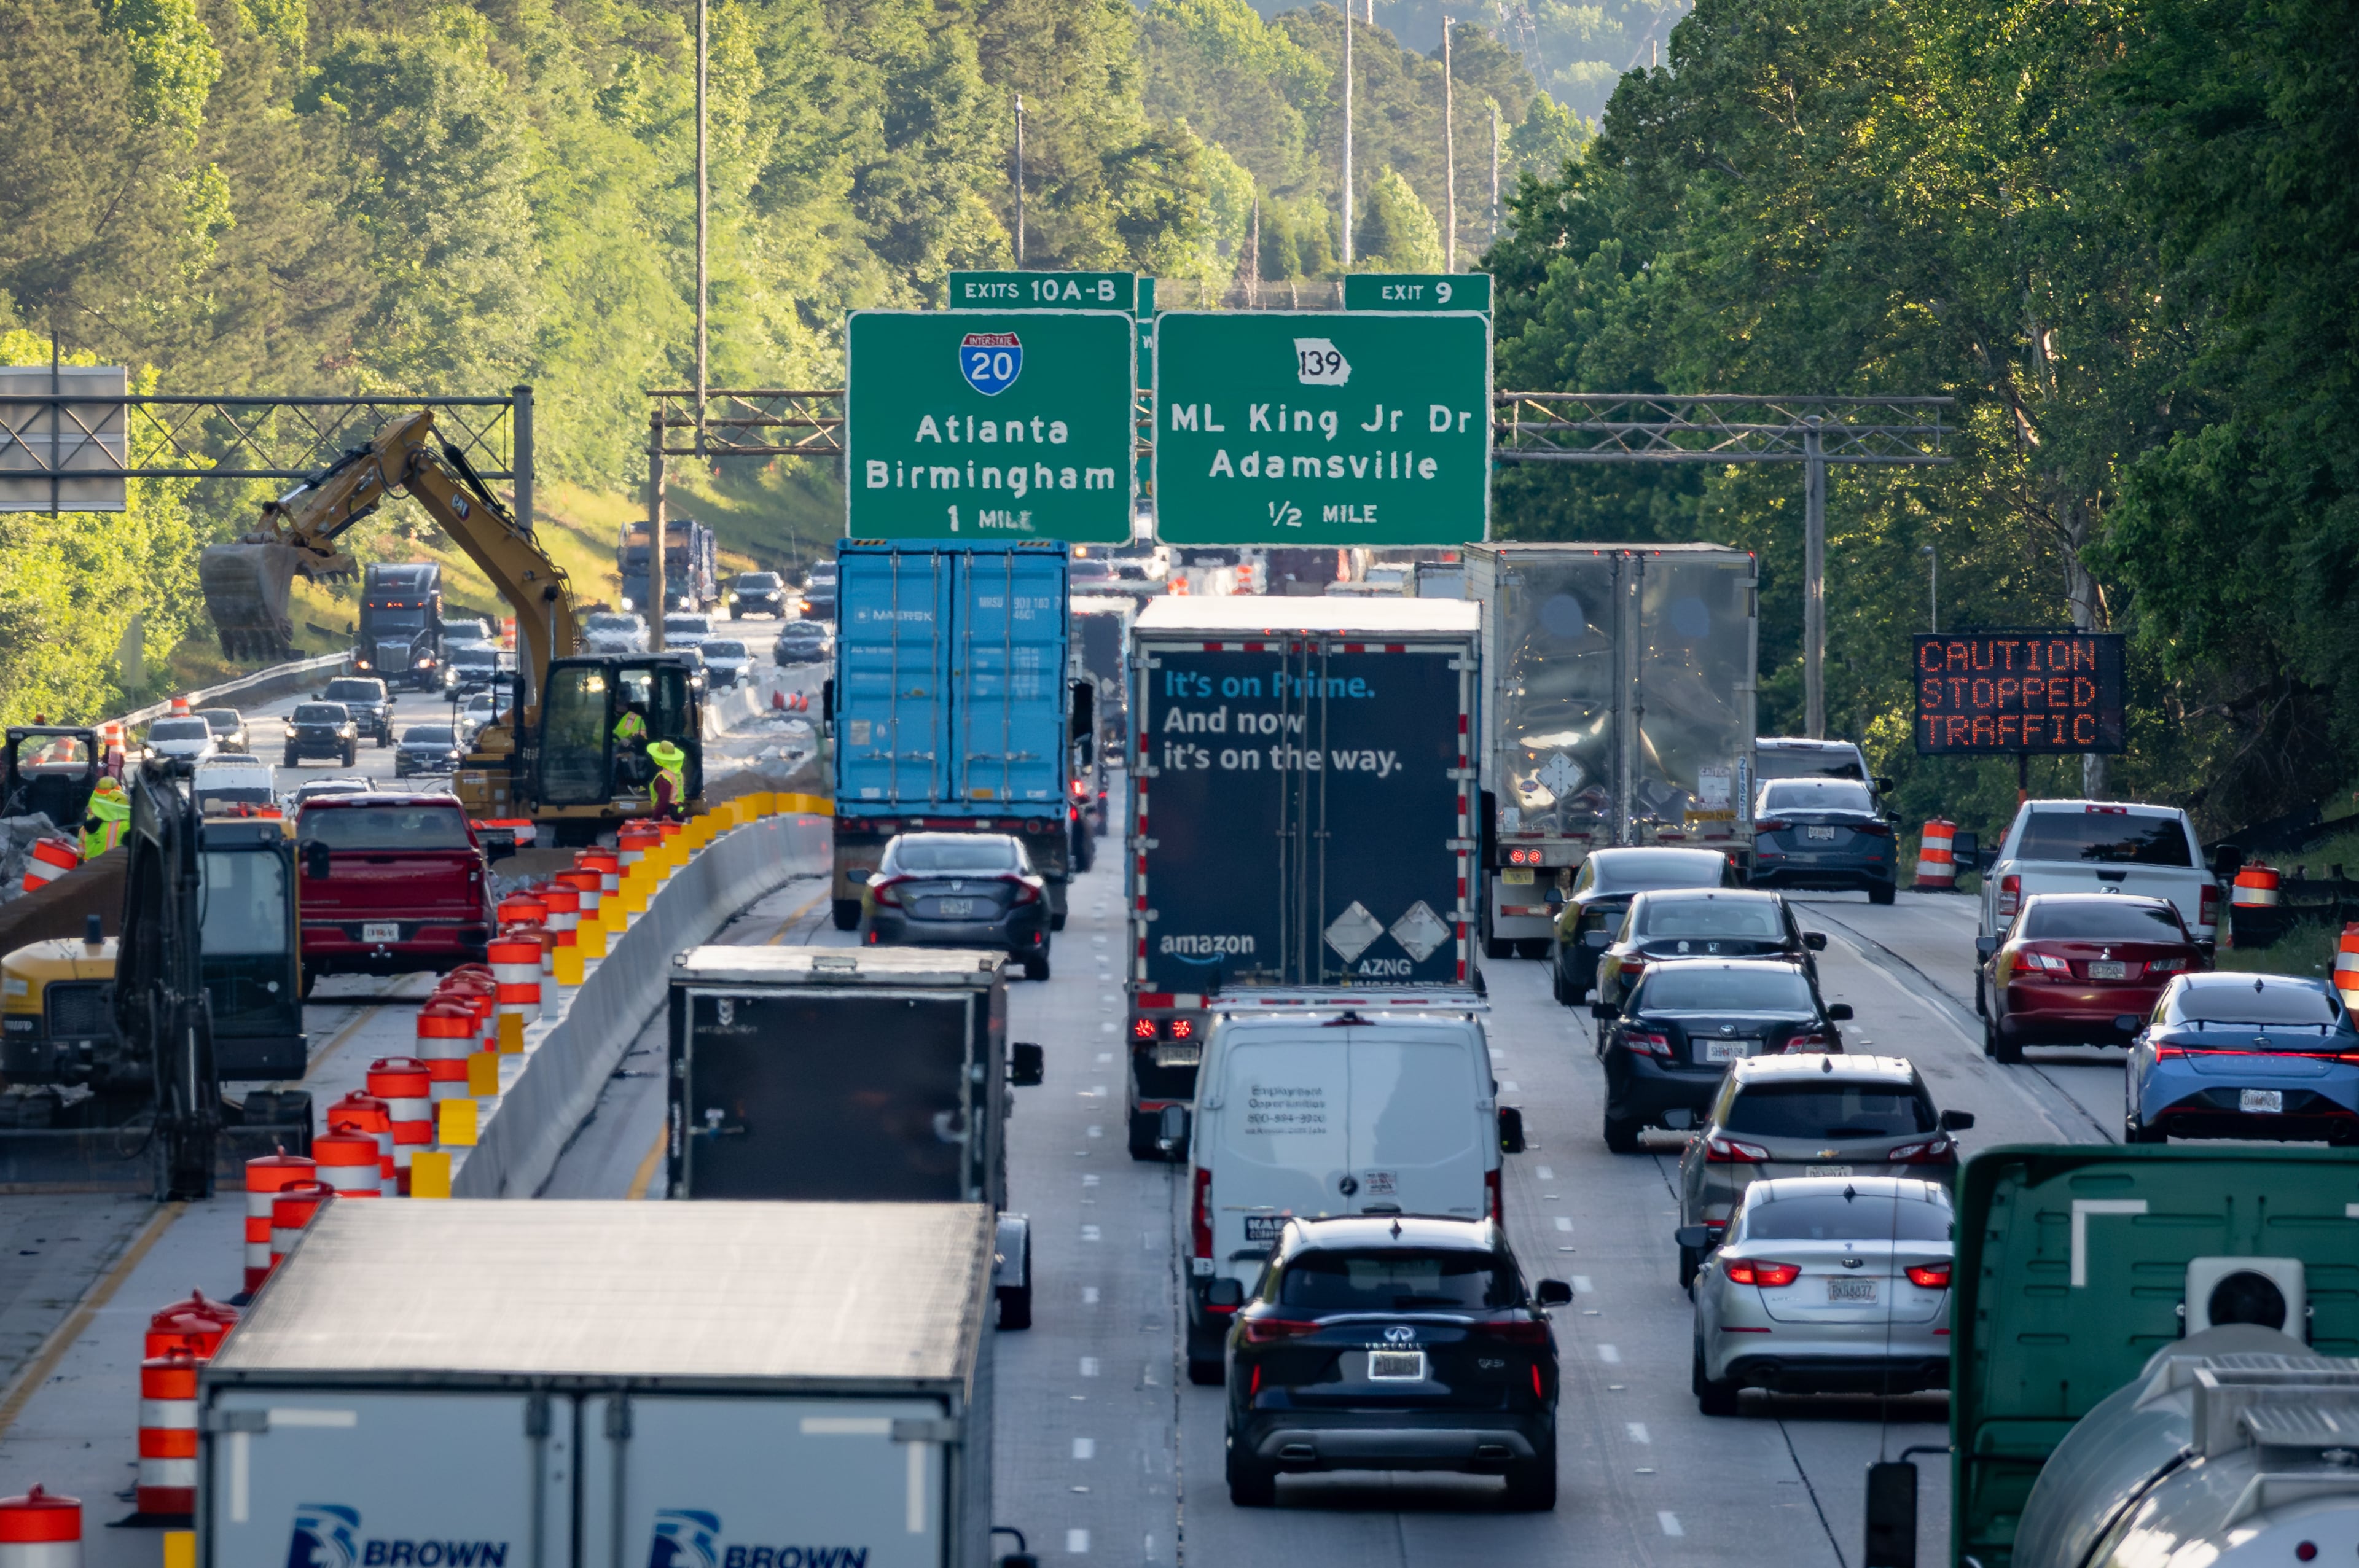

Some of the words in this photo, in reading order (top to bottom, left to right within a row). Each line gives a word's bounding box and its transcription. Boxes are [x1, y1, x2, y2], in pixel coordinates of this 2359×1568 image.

[965, 283, 1020, 298] EXITS
[1031, 279, 1116, 302] 10A-B
[1382, 284, 1425, 300] EXIT
[1435, 281, 1452, 304] 9
[969, 336, 1013, 345] INTERSTATE
[971, 352, 1013, 381] 20
[1299, 351, 1341, 376] 139
[915, 415, 1068, 445] Atlanta
[1172, 403, 1225, 432] ML
[1249, 403, 1339, 442] King
[1361, 404, 1404, 432] Jr
[1429, 404, 1472, 434] Dr
[1208, 449, 1438, 480] Adamsville
[867, 459, 1115, 499] Birmingham
[452, 493, 469, 517] CAT
[947, 505, 959, 532] 1
[979, 509, 1035, 531] MILE
[1323, 504, 1377, 524] MILE
[1920, 641, 2095, 672] CAUTION
[1166, 671, 1212, 698] It's
[1221, 677, 1261, 698] on
[1272, 671, 1376, 698] Prime.
[1921, 677, 2095, 708] STOPPED
[1164, 706, 1227, 733] And
[1238, 711, 1306, 733] now
[1921, 714, 2095, 746] TRAFFIC
[1164, 742, 1210, 770] it's
[1220, 749, 1260, 770] on
[1269, 744, 1323, 771] the
[1332, 751, 1402, 778] way.
[1160, 935, 1254, 954] amazon
[1358, 958, 1413, 975] AZNG
[363, 1540, 509, 1568] BROWN
[723, 1545, 868, 1568] BROWN
